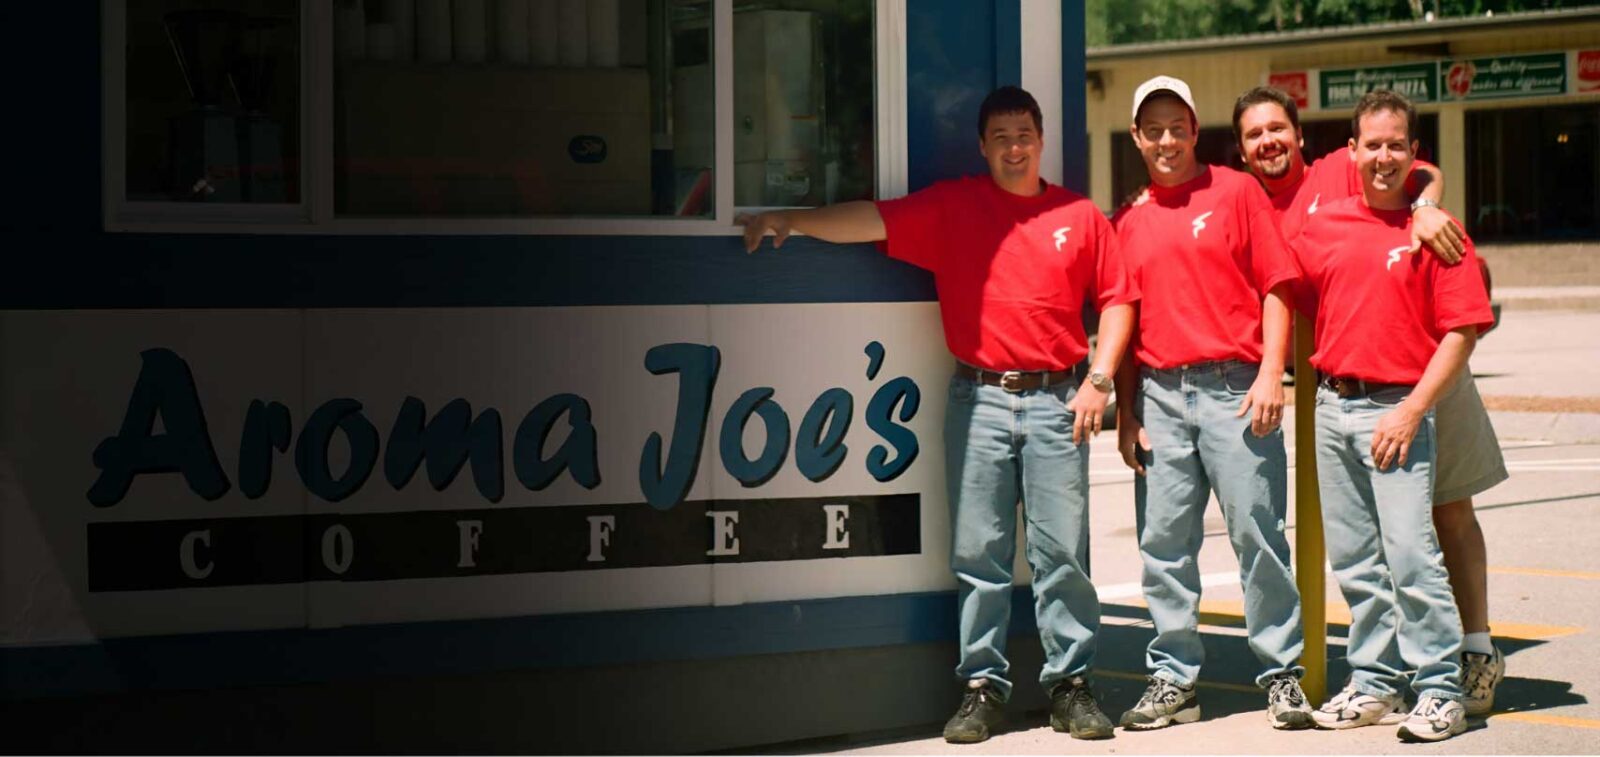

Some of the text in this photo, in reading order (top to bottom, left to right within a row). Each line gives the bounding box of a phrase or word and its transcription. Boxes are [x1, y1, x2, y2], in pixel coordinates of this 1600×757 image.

[87, 342, 921, 511] Aroma Joe's
[178, 504, 851, 580] COFFEE
